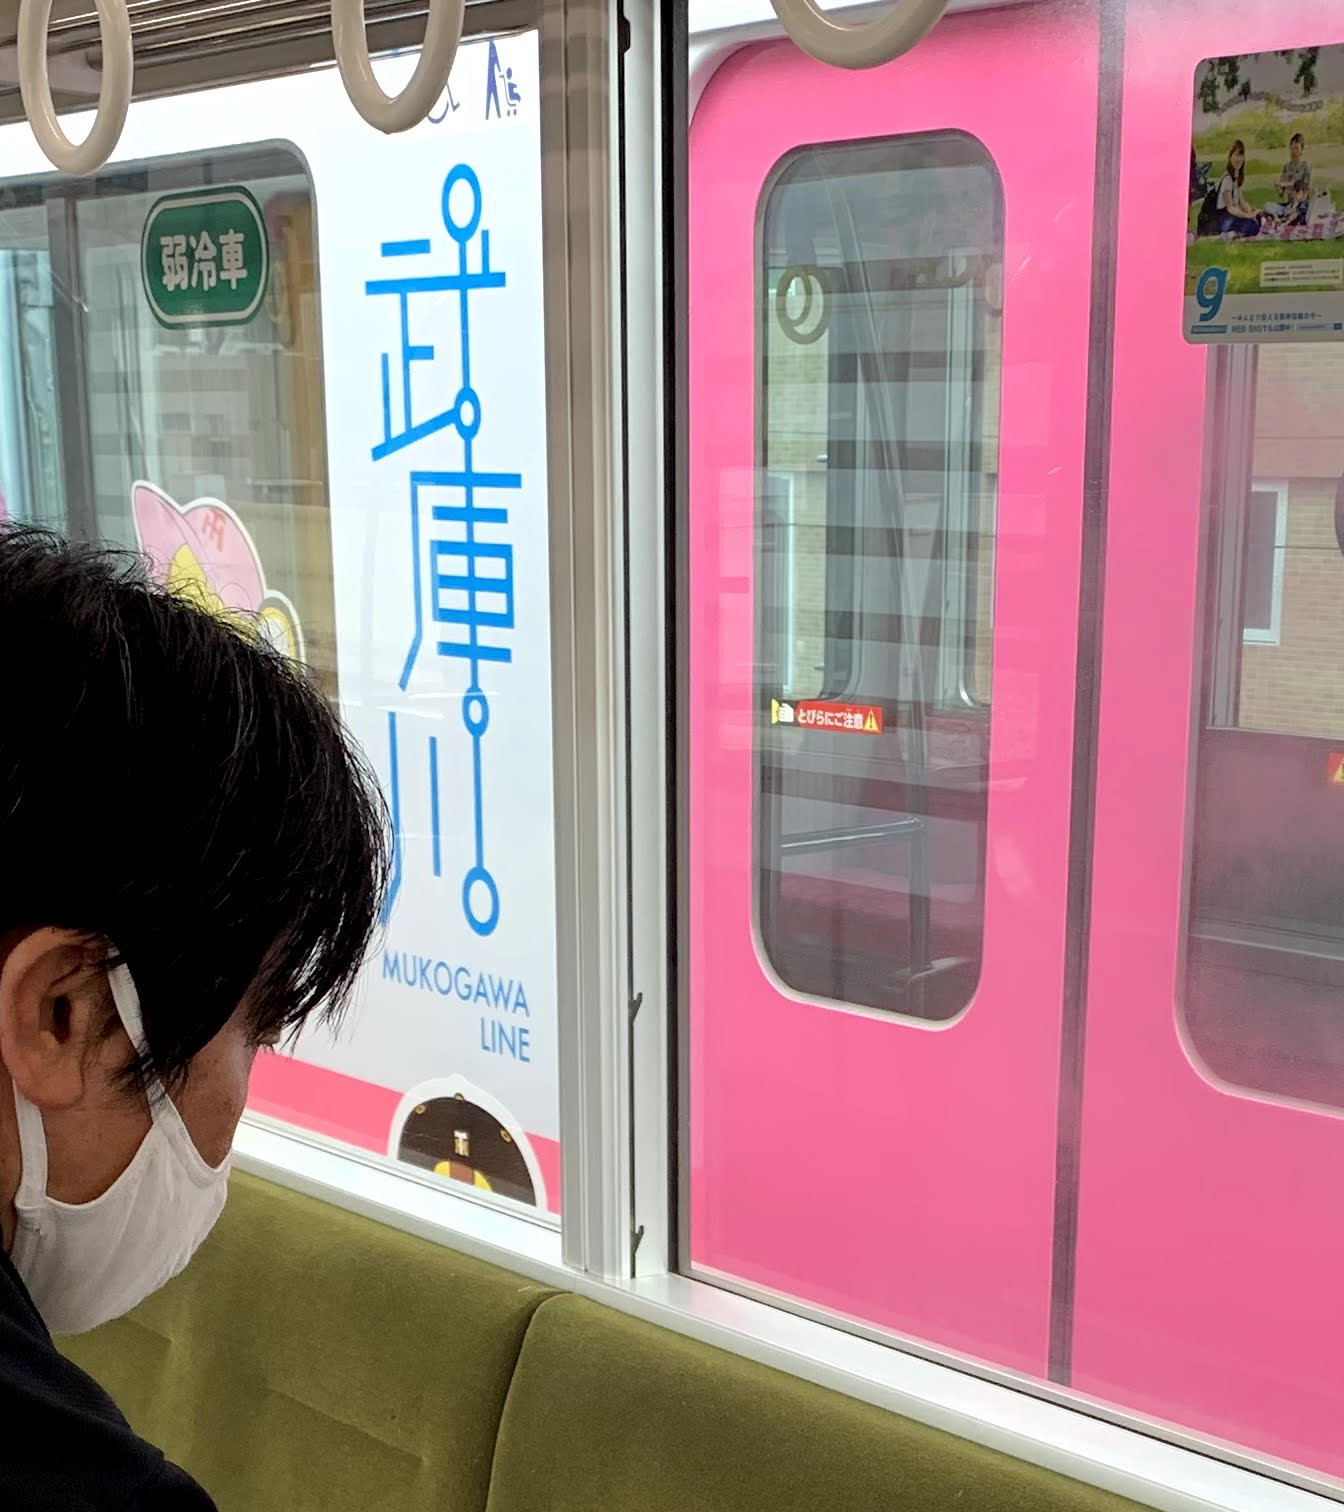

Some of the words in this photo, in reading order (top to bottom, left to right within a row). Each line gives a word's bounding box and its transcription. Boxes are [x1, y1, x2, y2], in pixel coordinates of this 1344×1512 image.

[160, 228, 249, 292] 弱冷車
[797, 708, 864, 730] とびらにご注意
[382, 950, 530, 1017] MUKOGAWA
[480, 1016, 530, 1063] LINE
